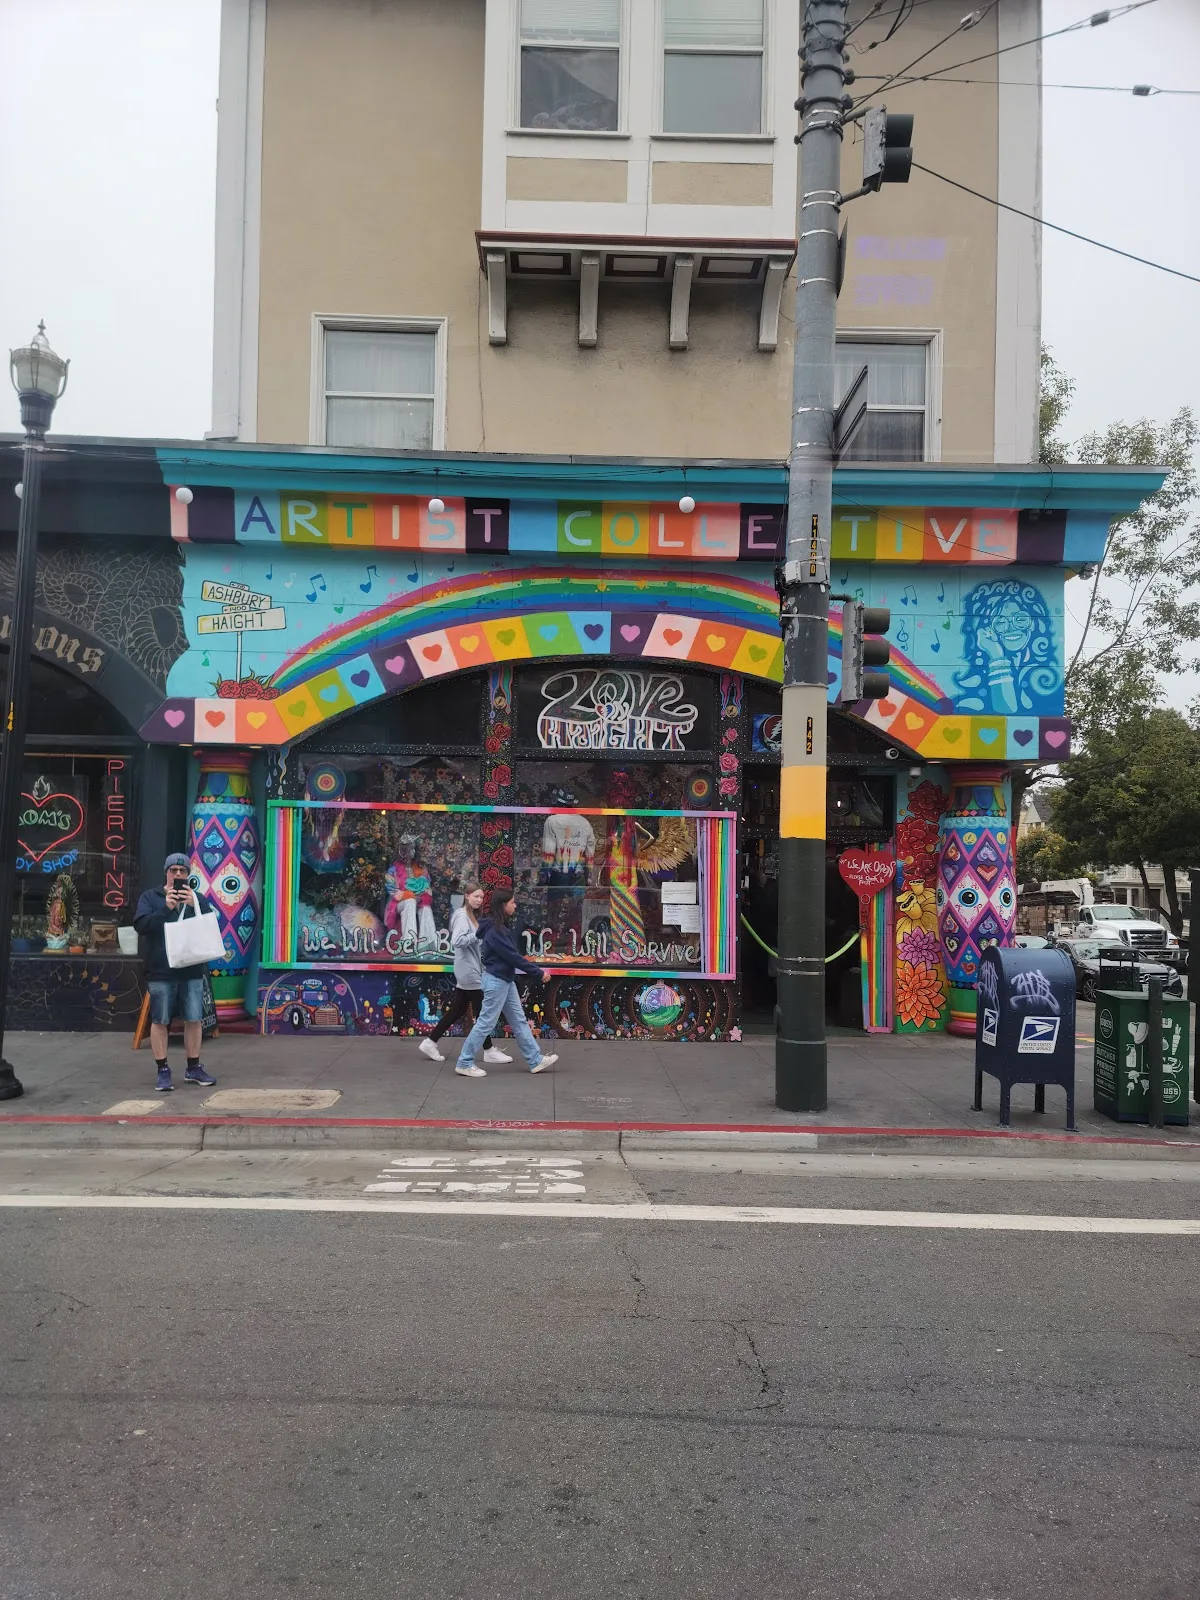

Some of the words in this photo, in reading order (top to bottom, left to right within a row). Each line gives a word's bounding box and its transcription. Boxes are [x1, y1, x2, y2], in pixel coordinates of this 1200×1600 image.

[240, 496, 502, 543] ARTIST
[563, 510, 1008, 554] COLLETIVE
[207, 586, 266, 608] ASHBURY
[212, 612, 266, 630] HAIGHT
[540, 668, 699, 722] LOVE
[537, 716, 695, 751] HAIGHT
[19, 809, 72, 831] OM'S
[104, 759, 125, 908] PIERCING
[15, 857, 35, 872] DY
[42, 848, 79, 873] SHOP
[301, 925, 337, 953] We
[521, 927, 564, 960] We
[1163, 1087, 1179, 1095] US'S
